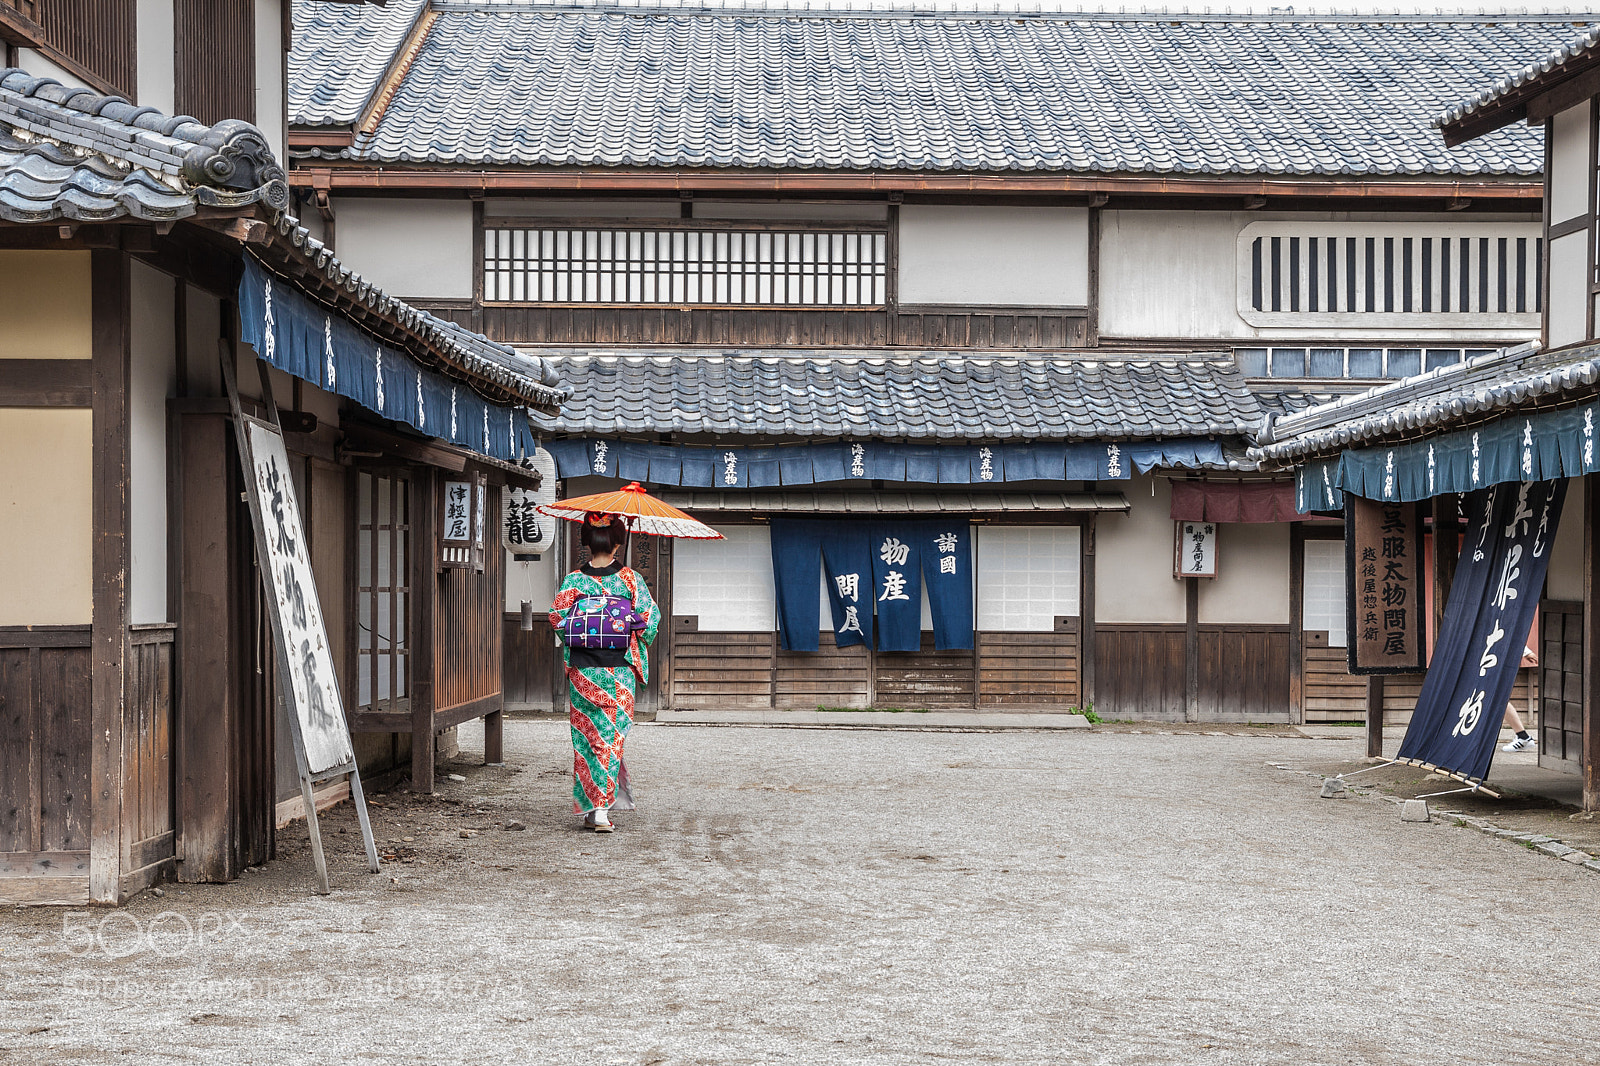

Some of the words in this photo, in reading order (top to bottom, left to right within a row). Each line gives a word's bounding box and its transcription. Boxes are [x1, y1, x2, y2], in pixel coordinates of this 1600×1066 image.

[593, 440, 609, 474] 海産物
[723, 451, 738, 486] 海産物
[851, 443, 866, 477] 海産物
[979, 447, 994, 481] 海産物
[1107, 444, 1122, 478] 海産物
[878, 537, 910, 602] 物産
[933, 532, 958, 575] 諸國
